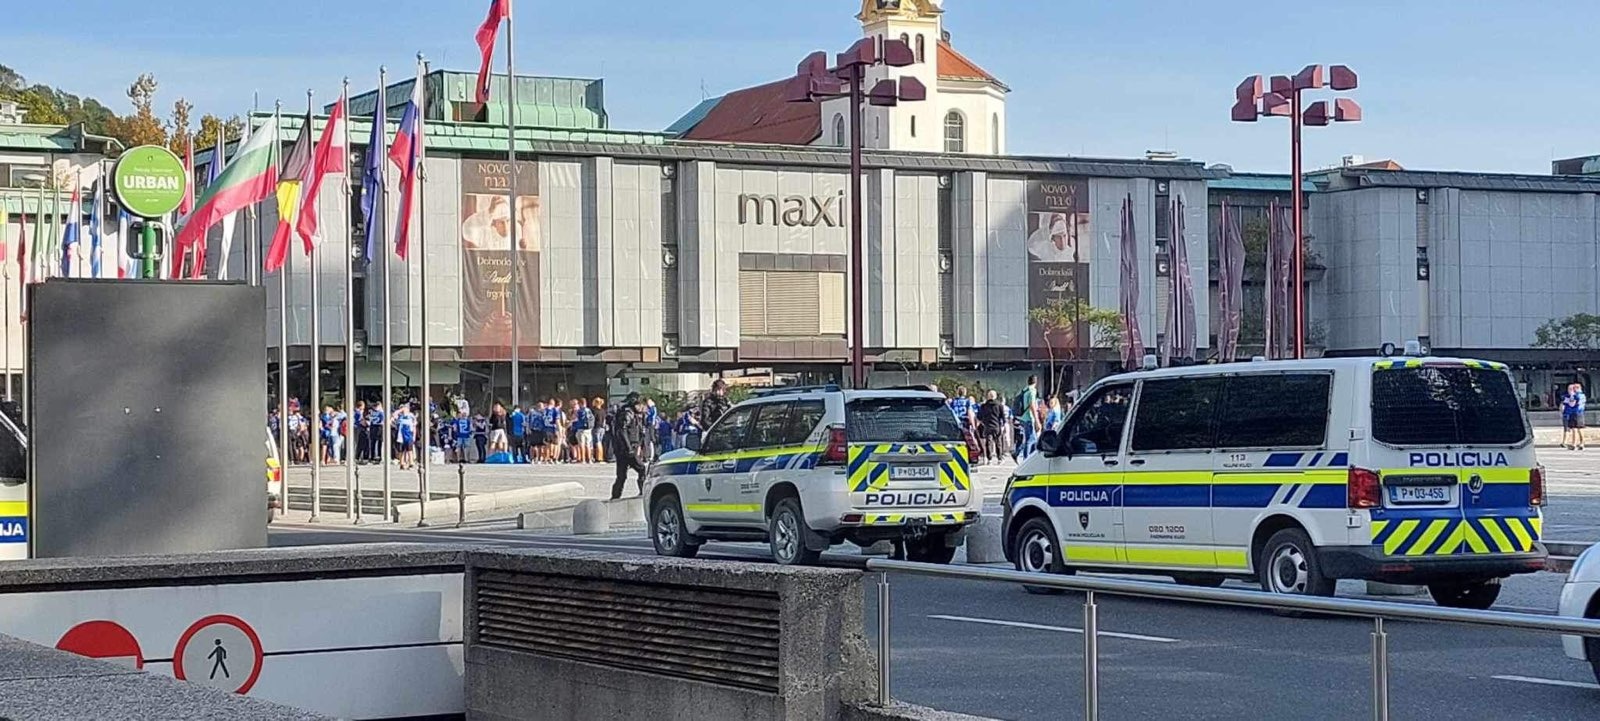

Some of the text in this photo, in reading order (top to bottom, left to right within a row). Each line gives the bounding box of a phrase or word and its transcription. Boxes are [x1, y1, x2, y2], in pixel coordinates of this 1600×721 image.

[123, 175, 179, 190] URBAN
[1040, 184, 1067, 194] NOVO
[738, 190, 844, 227] maxi
[1409, 452, 1508, 467] POLICIJA
[865, 492, 957, 506] POLICIJA
[1060, 490, 1108, 502] POLICIJA
